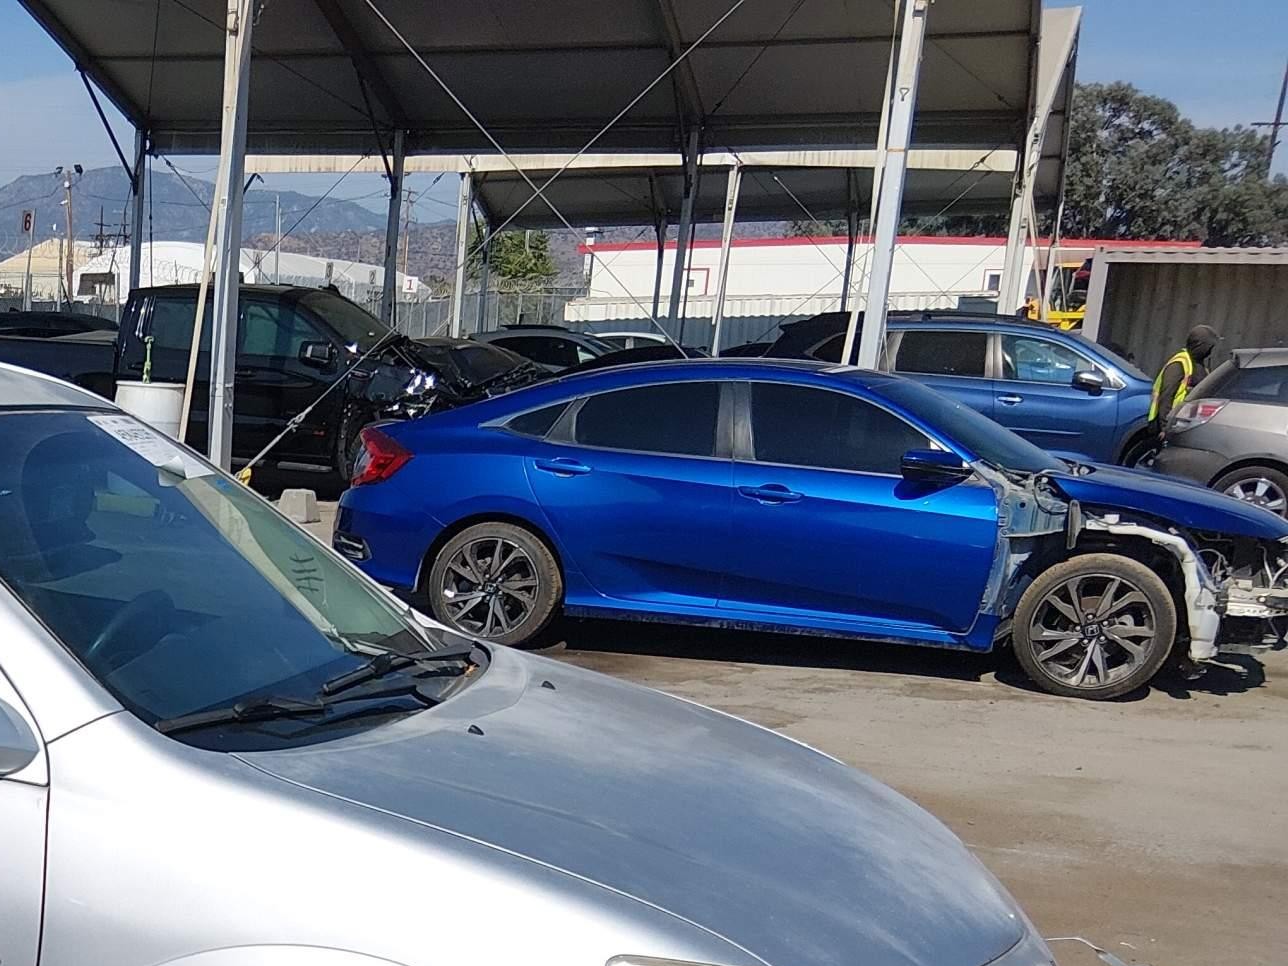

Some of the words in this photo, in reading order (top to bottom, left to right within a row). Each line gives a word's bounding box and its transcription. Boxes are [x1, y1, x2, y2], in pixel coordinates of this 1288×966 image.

[24, 213, 32, 231] 6
[369, 271, 375, 285] 2
[406, 279, 413, 290] 1
